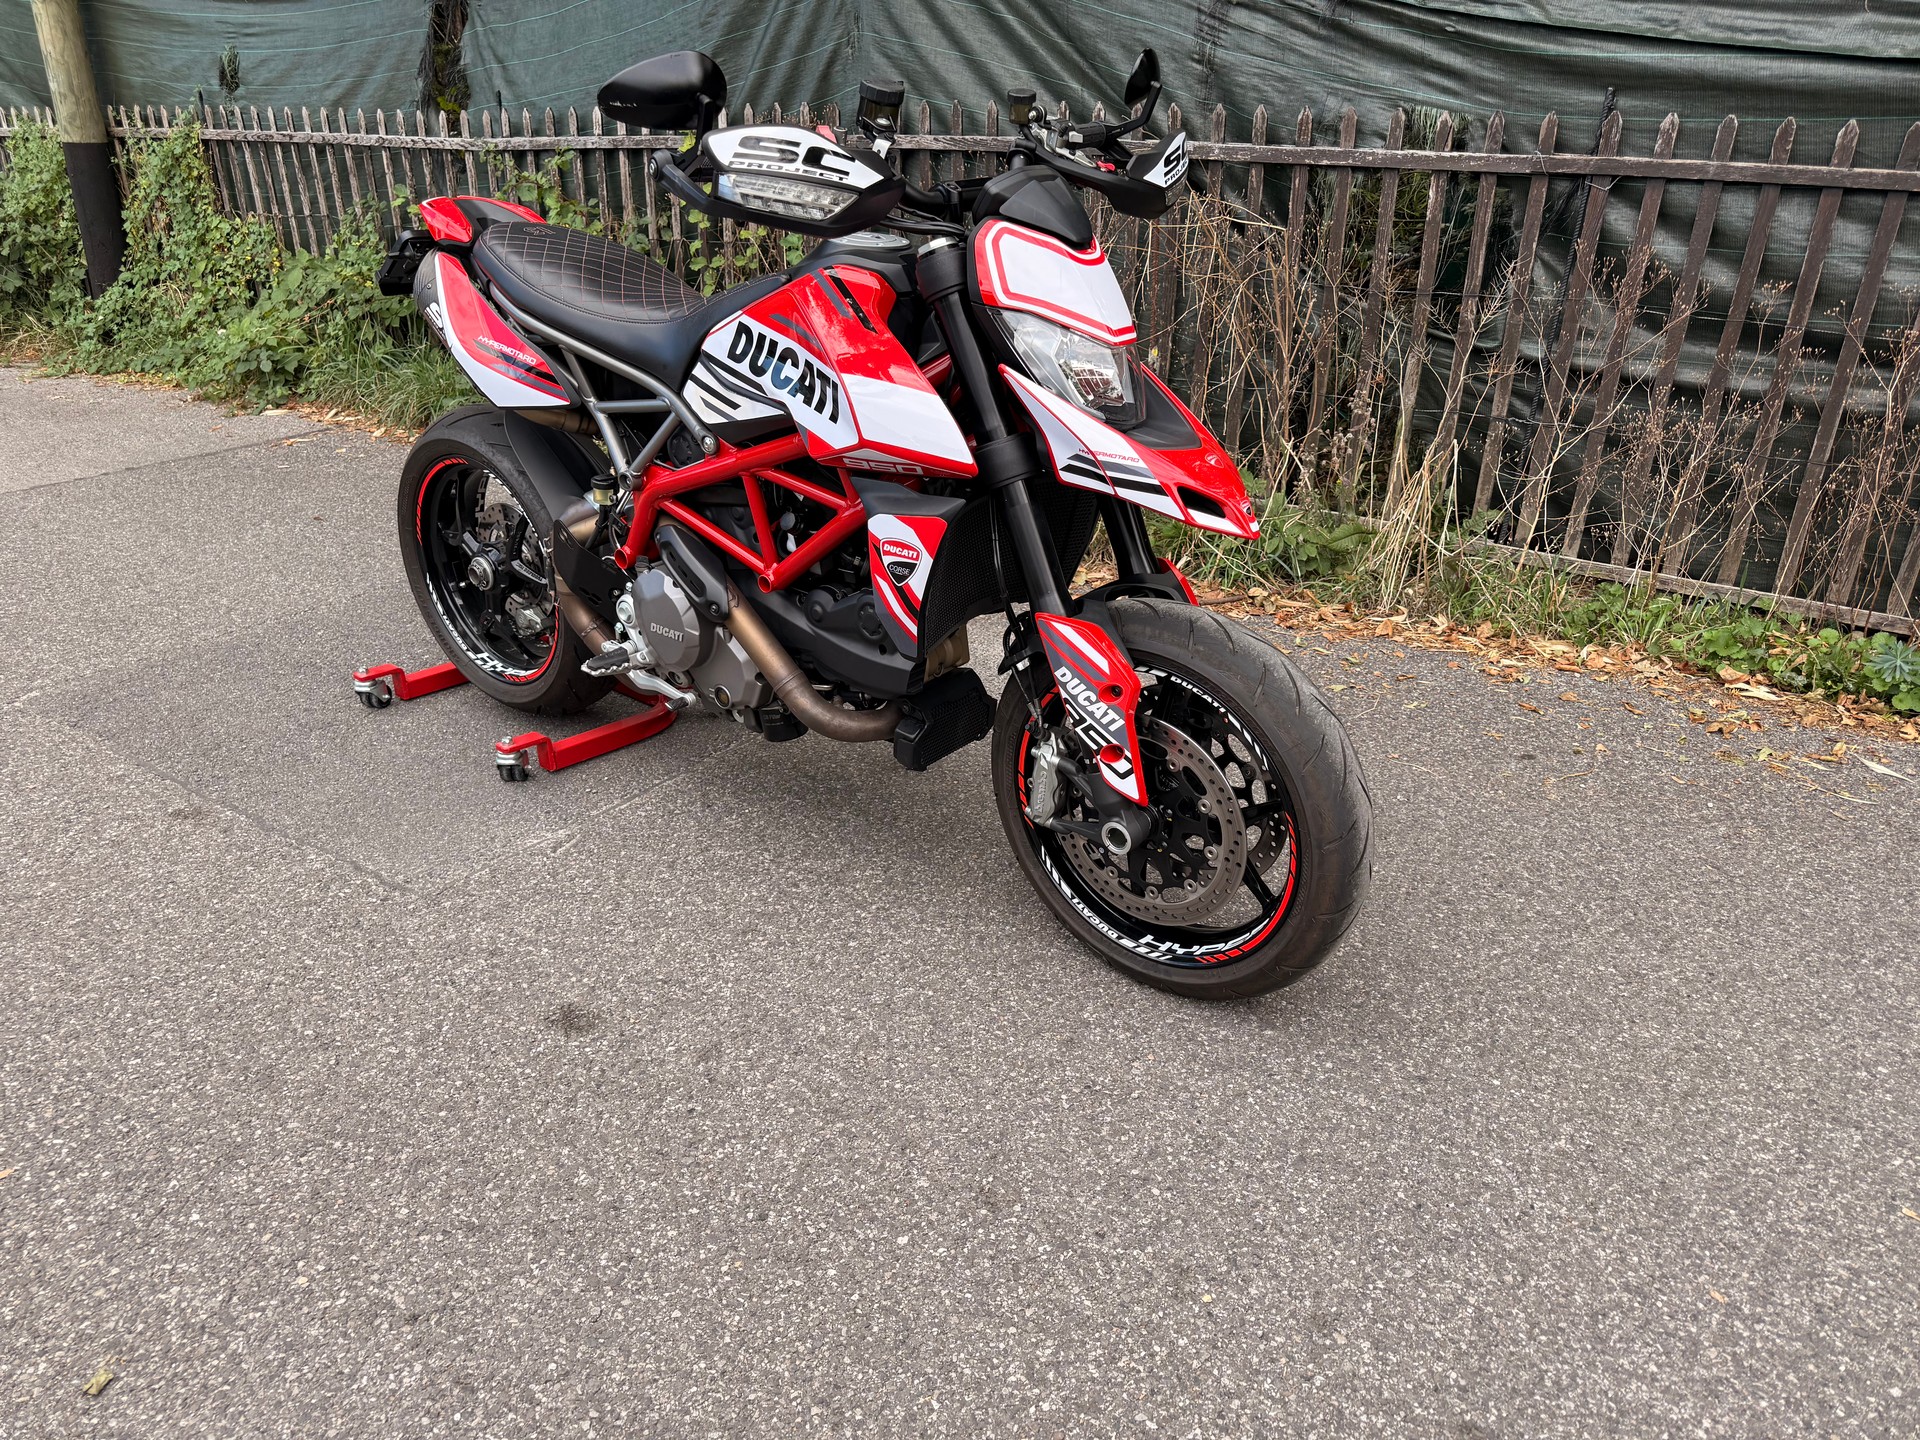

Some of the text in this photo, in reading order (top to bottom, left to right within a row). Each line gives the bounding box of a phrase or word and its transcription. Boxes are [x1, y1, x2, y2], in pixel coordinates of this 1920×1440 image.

[728, 160, 849, 181] PROJECT
[732, 136, 856, 176] SC
[478, 335, 537, 366] HYPERMOTARD
[727, 321, 840, 424] DUCATI
[843, 458, 925, 475] 950
[883, 543, 918, 559] DUCATI
[889, 564, 910, 576] CORSE
[650, 622, 684, 642] DUCATI
[1054, 666, 1126, 732] DUCATI
[1170, 675, 1226, 713] DUCATI
[1071, 898, 1119, 939] DUCATI
